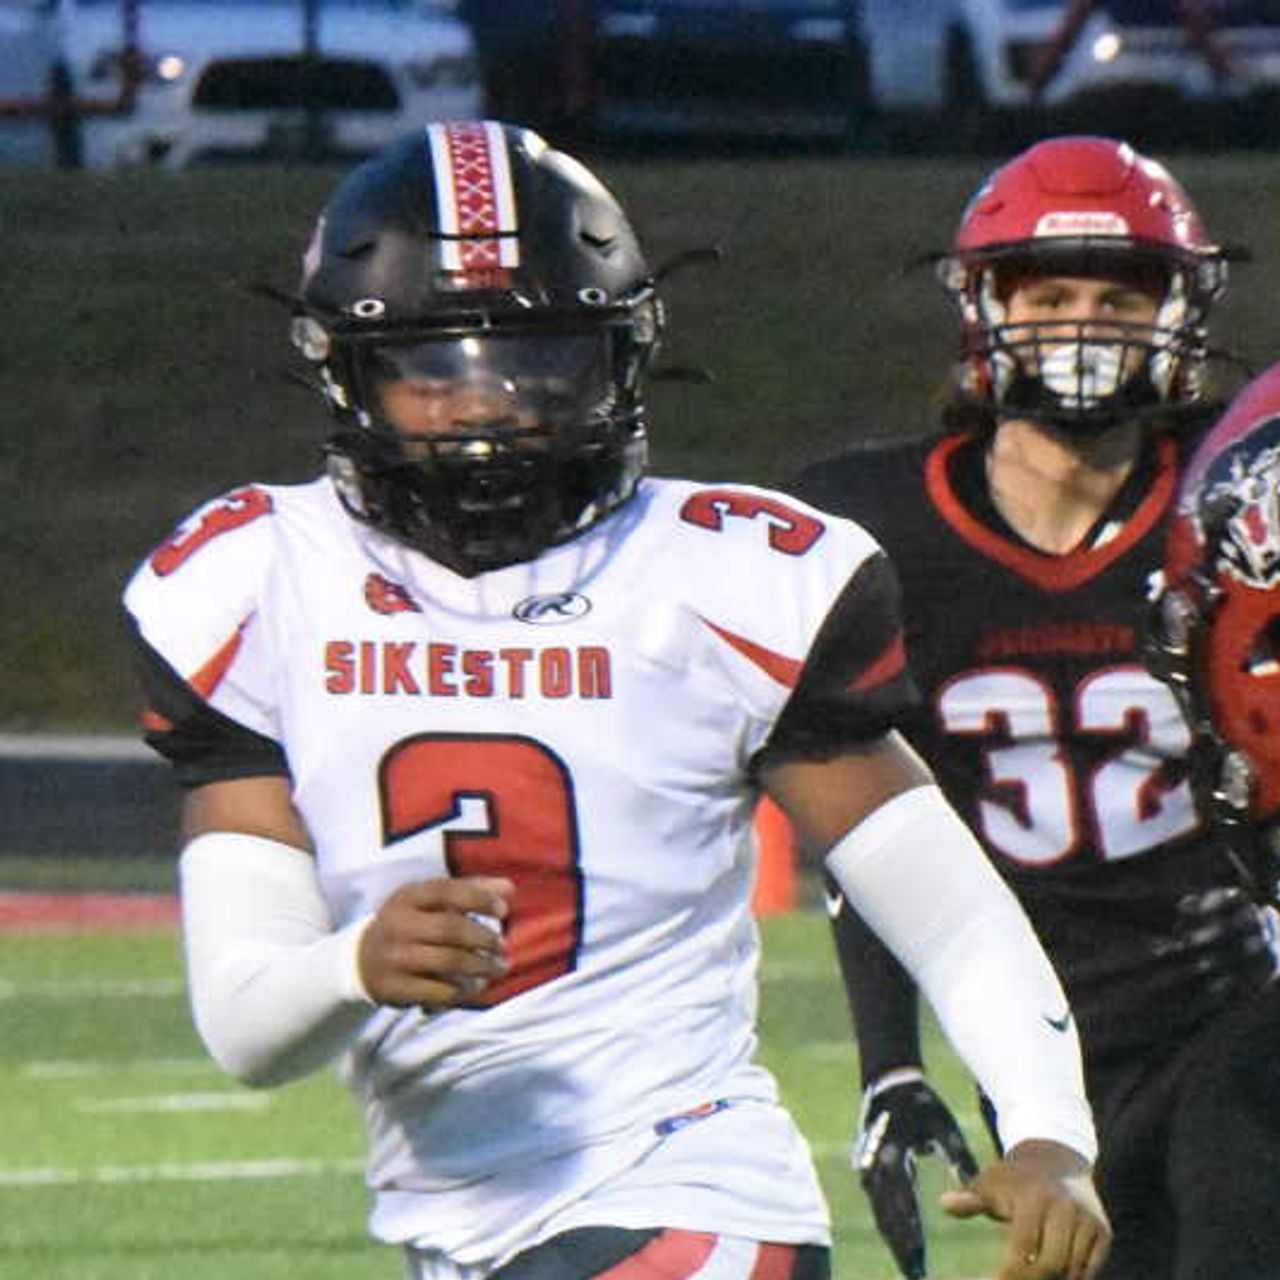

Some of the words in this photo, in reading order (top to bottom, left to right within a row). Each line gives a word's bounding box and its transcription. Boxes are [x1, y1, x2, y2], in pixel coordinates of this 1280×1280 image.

[680, 488, 827, 556] 3
[323, 640, 613, 699] SIKESTON
[938, 663, 1203, 869] 32
[377, 731, 585, 1011] 3
